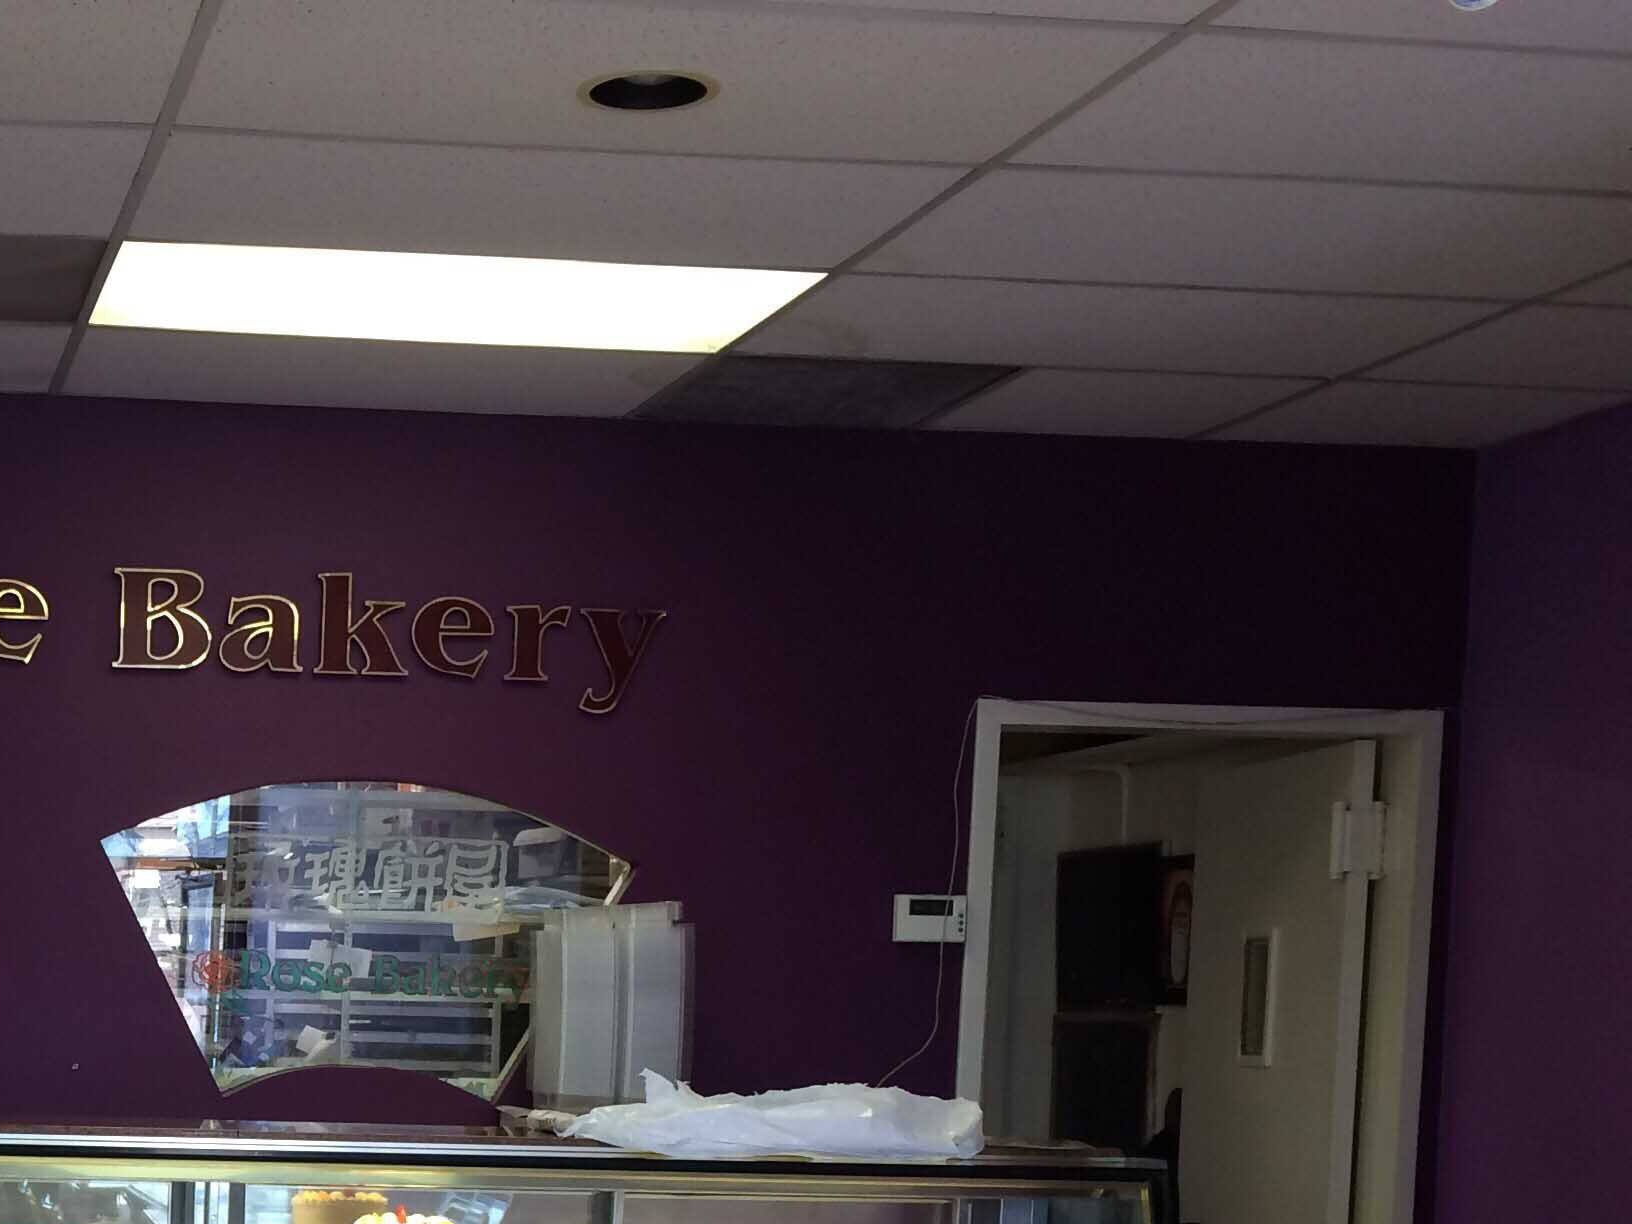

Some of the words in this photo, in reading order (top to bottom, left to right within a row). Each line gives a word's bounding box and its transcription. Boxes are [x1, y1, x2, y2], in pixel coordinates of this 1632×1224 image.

[112, 567, 667, 714] Bakery
[239, 949, 353, 994] Rose
[370, 952, 530, 1003] Bakery
